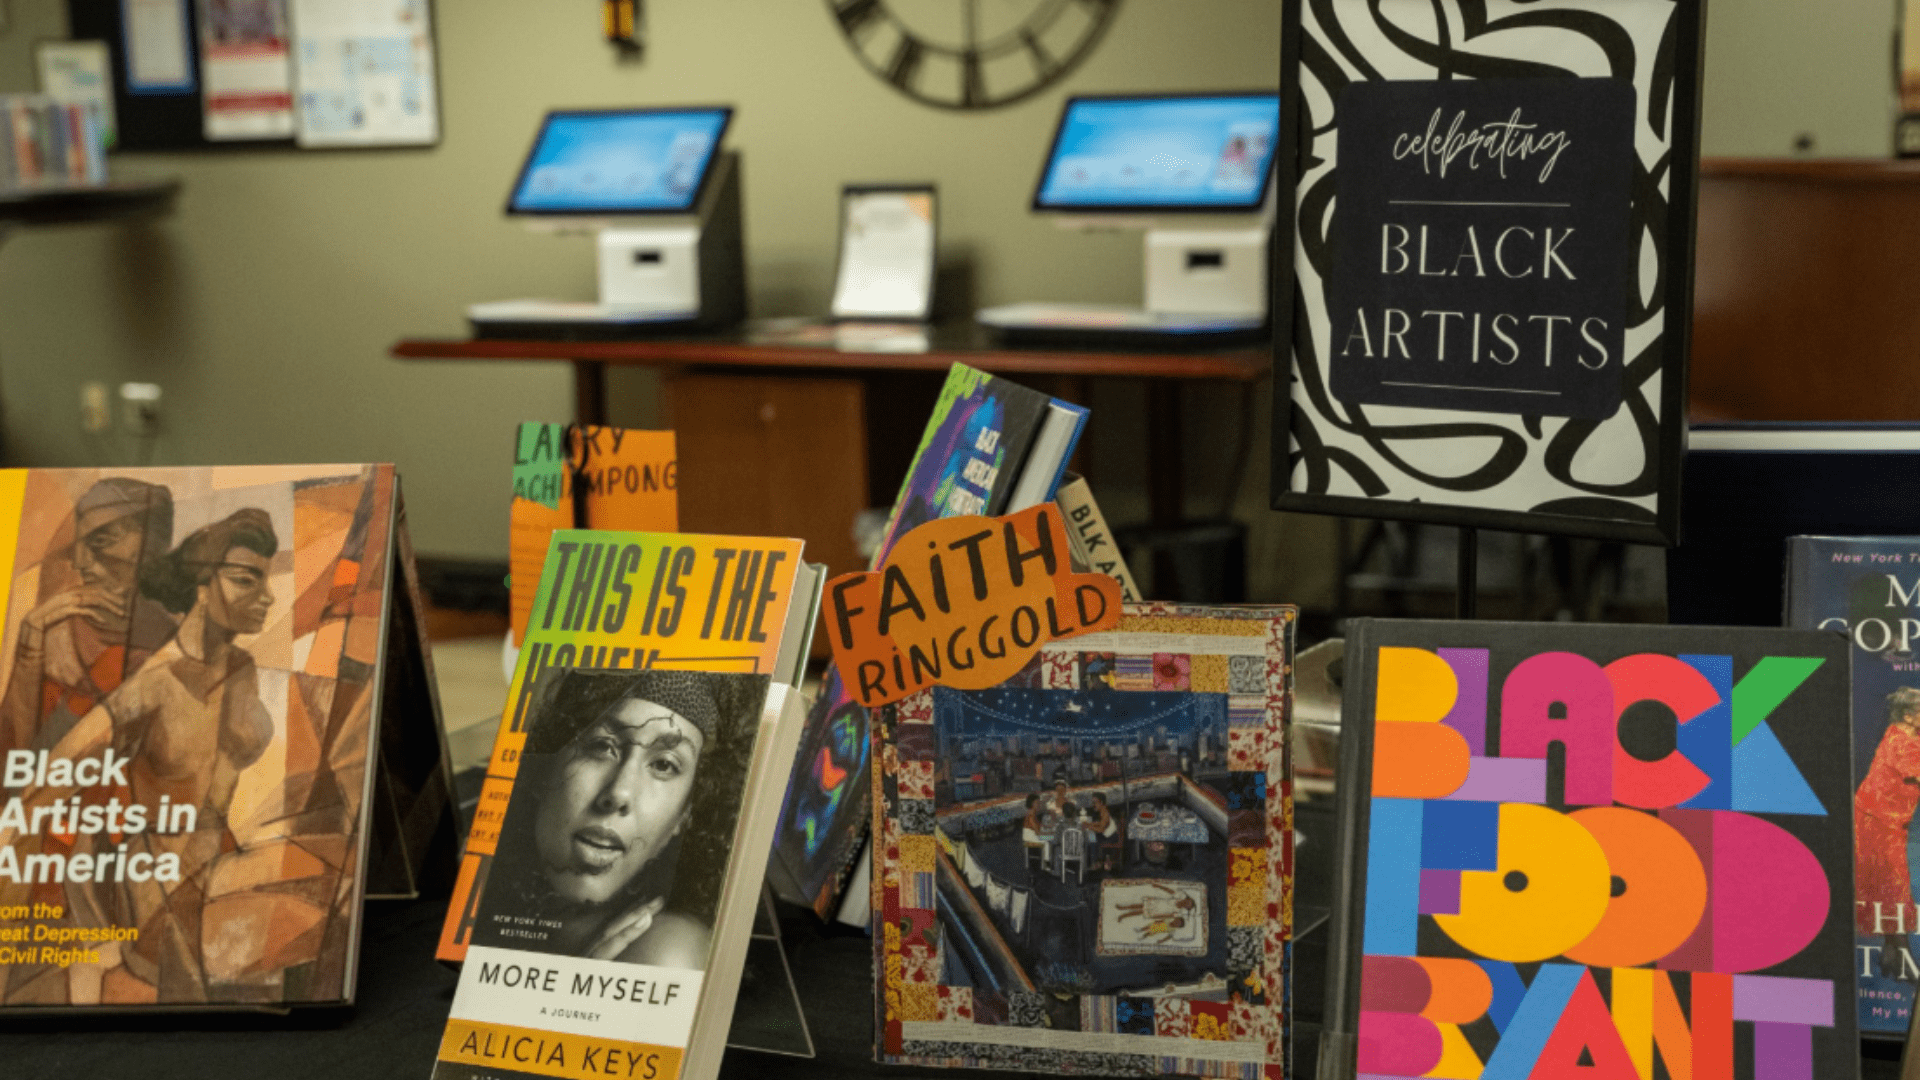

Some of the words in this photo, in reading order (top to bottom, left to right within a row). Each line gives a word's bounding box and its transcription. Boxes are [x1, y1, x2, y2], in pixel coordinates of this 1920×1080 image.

[1393, 107, 1571, 183] celebrating
[1381, 223, 1577, 281] BLACK
[1341, 307, 1609, 370] ARTISTS
[515, 423, 625, 465] LARY
[514, 460, 678, 501] ACHIMPONG
[1070, 504, 1107, 553] BLK
[1831, 553, 1864, 563] New
[1870, 553, 1903, 563] York
[542, 542, 643, 634] THIS
[640, 545, 696, 638] IS
[700, 548, 786, 643] THE
[1371, 647, 1828, 816] BLACK
[3, 748, 130, 788] Black
[0, 796, 148, 835] Artists
[157, 795, 197, 834] in
[0, 844, 181, 884] America
[1363, 797, 1831, 974] FOOD
[0, 904, 30, 919] om
[33, 902, 63, 919] the
[0, 925, 30, 942] eat
[33, 924, 139, 945] Depression
[0, 947, 37, 965] Civil
[40, 947, 100, 969] Rights
[478, 962, 559, 992] MORE
[571, 973, 681, 1006] MYSELF
[540, 1006, 548, 1015] A
[551, 1008, 601, 1022] JOURNEY
[1356, 954, 1835, 1080] BRYANT
[460, 1030, 565, 1068] ALICIA
[582, 1046, 661, 1080] KEYS
